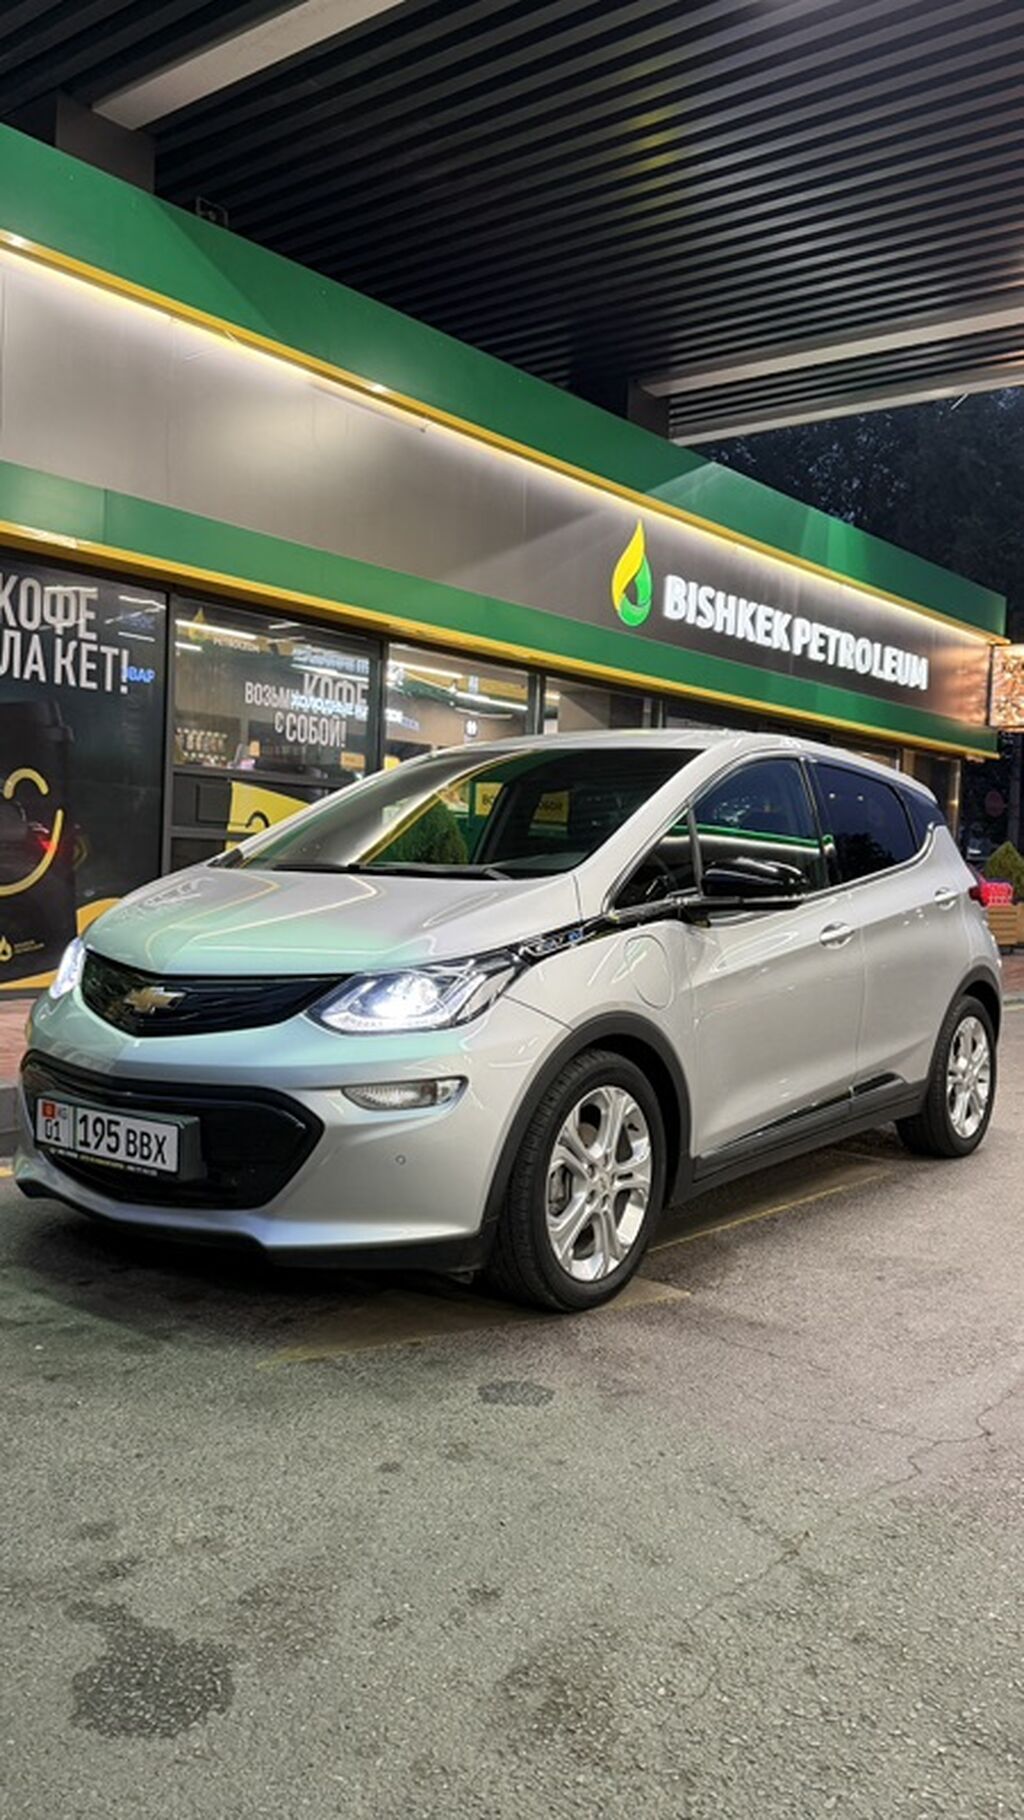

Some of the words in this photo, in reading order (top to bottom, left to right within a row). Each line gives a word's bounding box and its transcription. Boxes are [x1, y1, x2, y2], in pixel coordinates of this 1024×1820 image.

[0, 572, 98, 641] КОФЕ
[663, 574, 793, 652] BISHKEK
[792, 617, 928, 691] PETROLEUM
[54, 637, 130, 694] КЕТ!
[285, 713, 348, 748] СОБОЙ!
[44, 1119, 61, 1142] 01
[79, 1114, 120, 1154] 195
[125, 1128, 167, 1165] BBX
